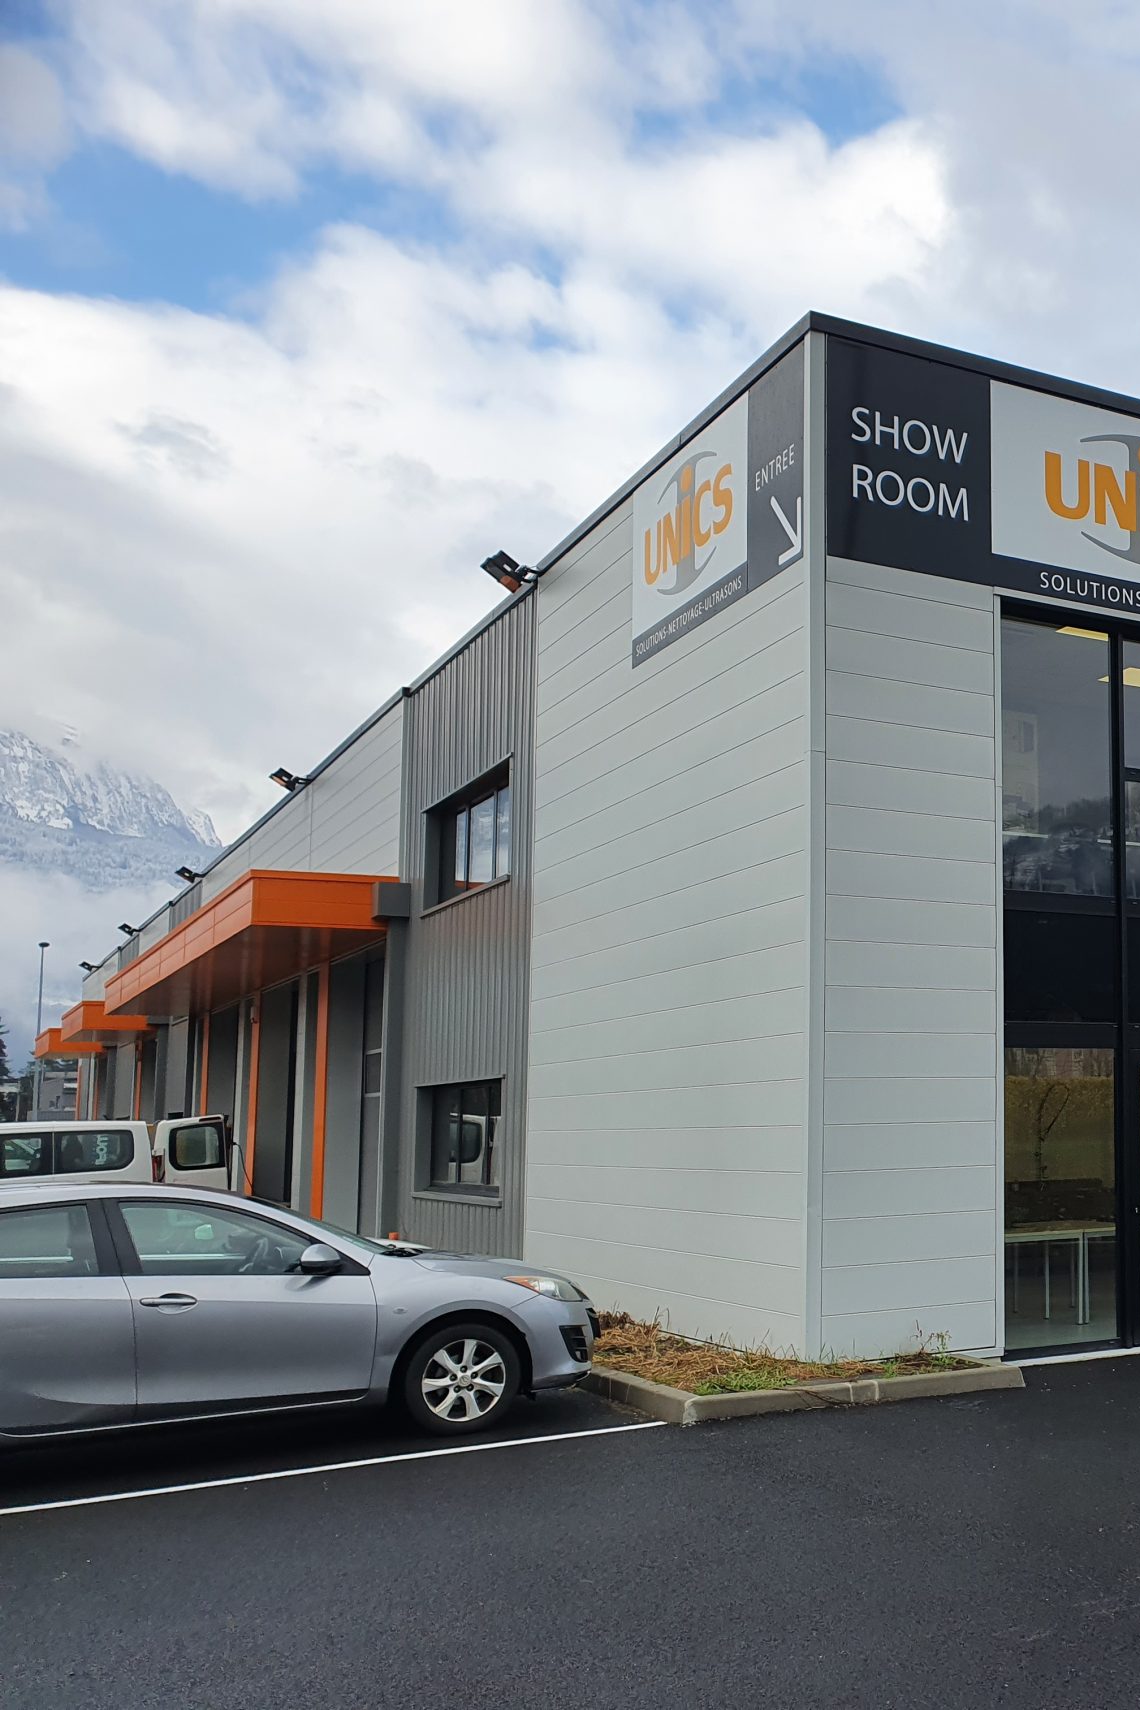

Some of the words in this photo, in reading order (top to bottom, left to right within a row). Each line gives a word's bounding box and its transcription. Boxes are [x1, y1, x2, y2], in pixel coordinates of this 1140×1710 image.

[851, 406, 968, 464] SHOW
[755, 443, 795, 491] ENTREE
[852, 464, 969, 521] ROOM
[635, 575, 742, 656] SOLUTIONS-NETTOYAGE-ULTRASONS
